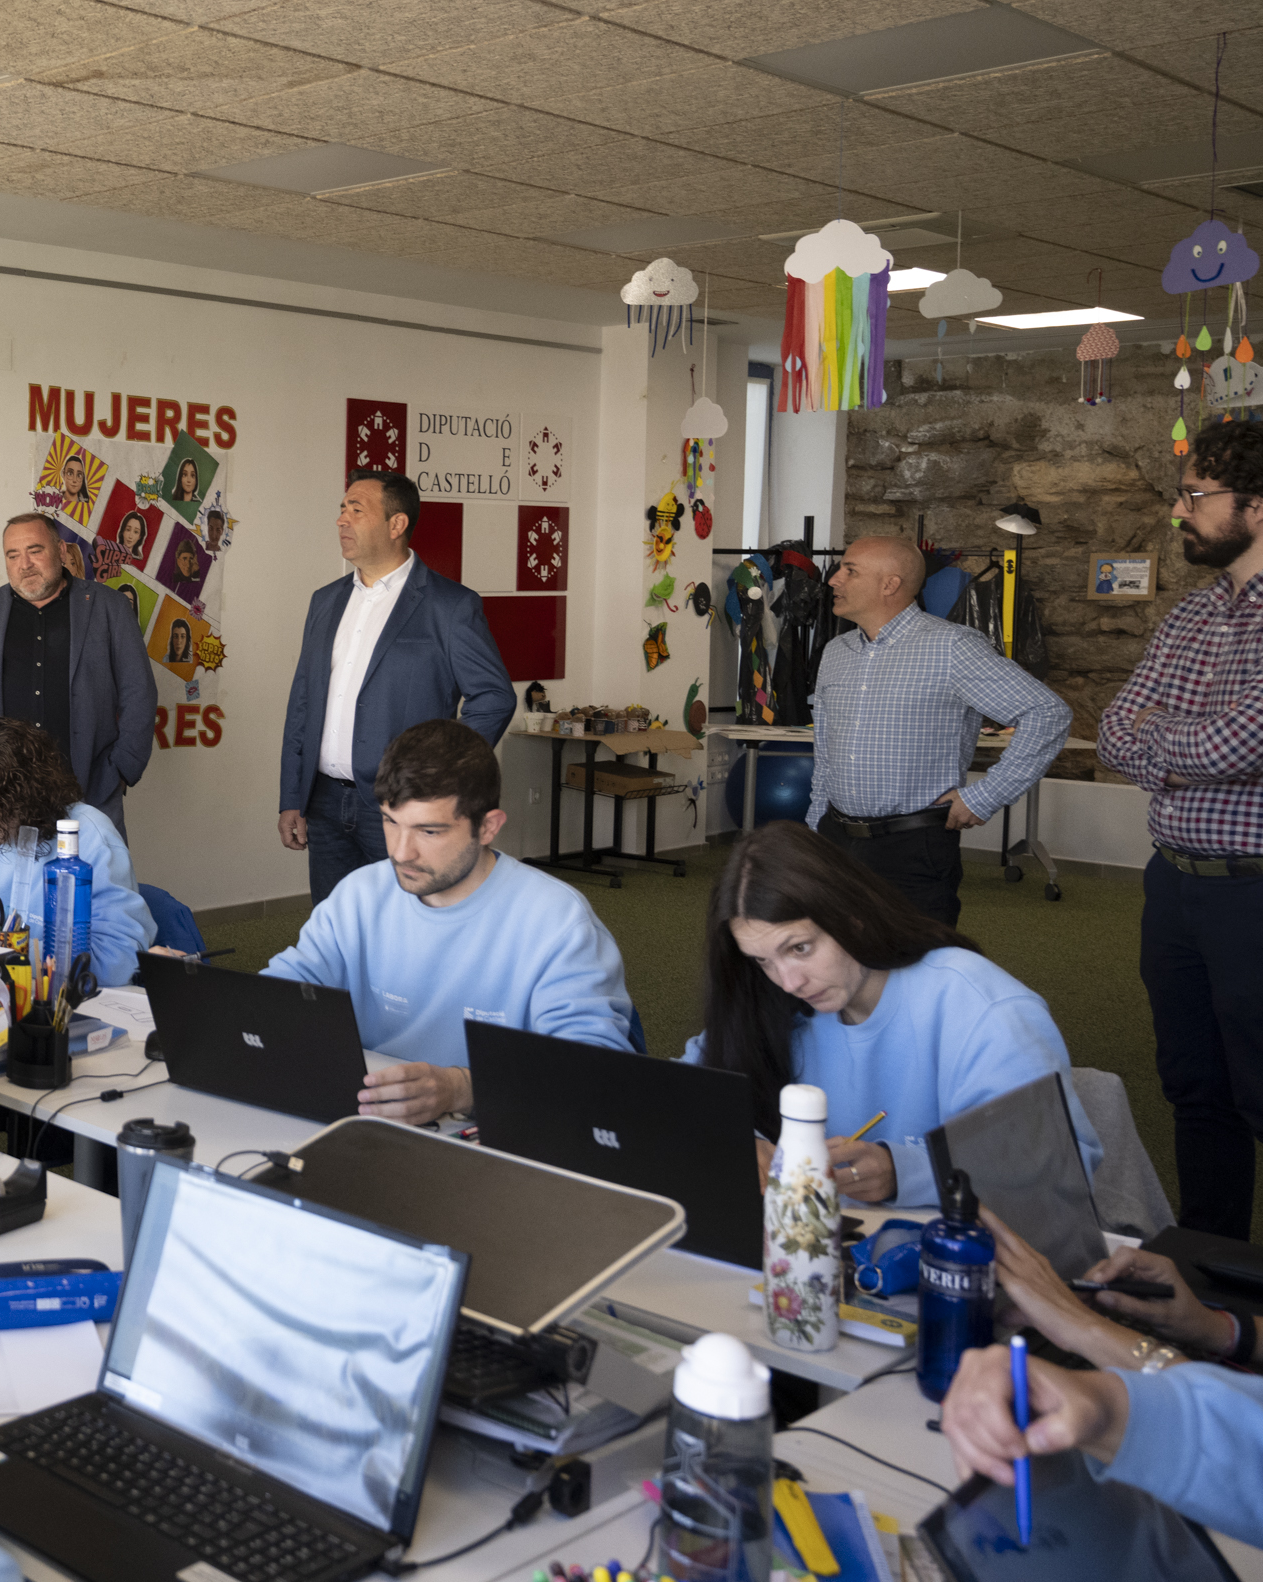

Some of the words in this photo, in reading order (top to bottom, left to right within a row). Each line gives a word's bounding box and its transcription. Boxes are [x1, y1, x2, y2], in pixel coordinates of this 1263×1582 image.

[28, 383, 237, 450] MUJERES
[418, 412, 512, 439] DIPUTACIÓ
[417, 469, 511, 496] CASTELLÓ
[35, 491, 63, 509] WOW
[93, 544, 133, 568] SUPER
[154, 703, 226, 750] RES
